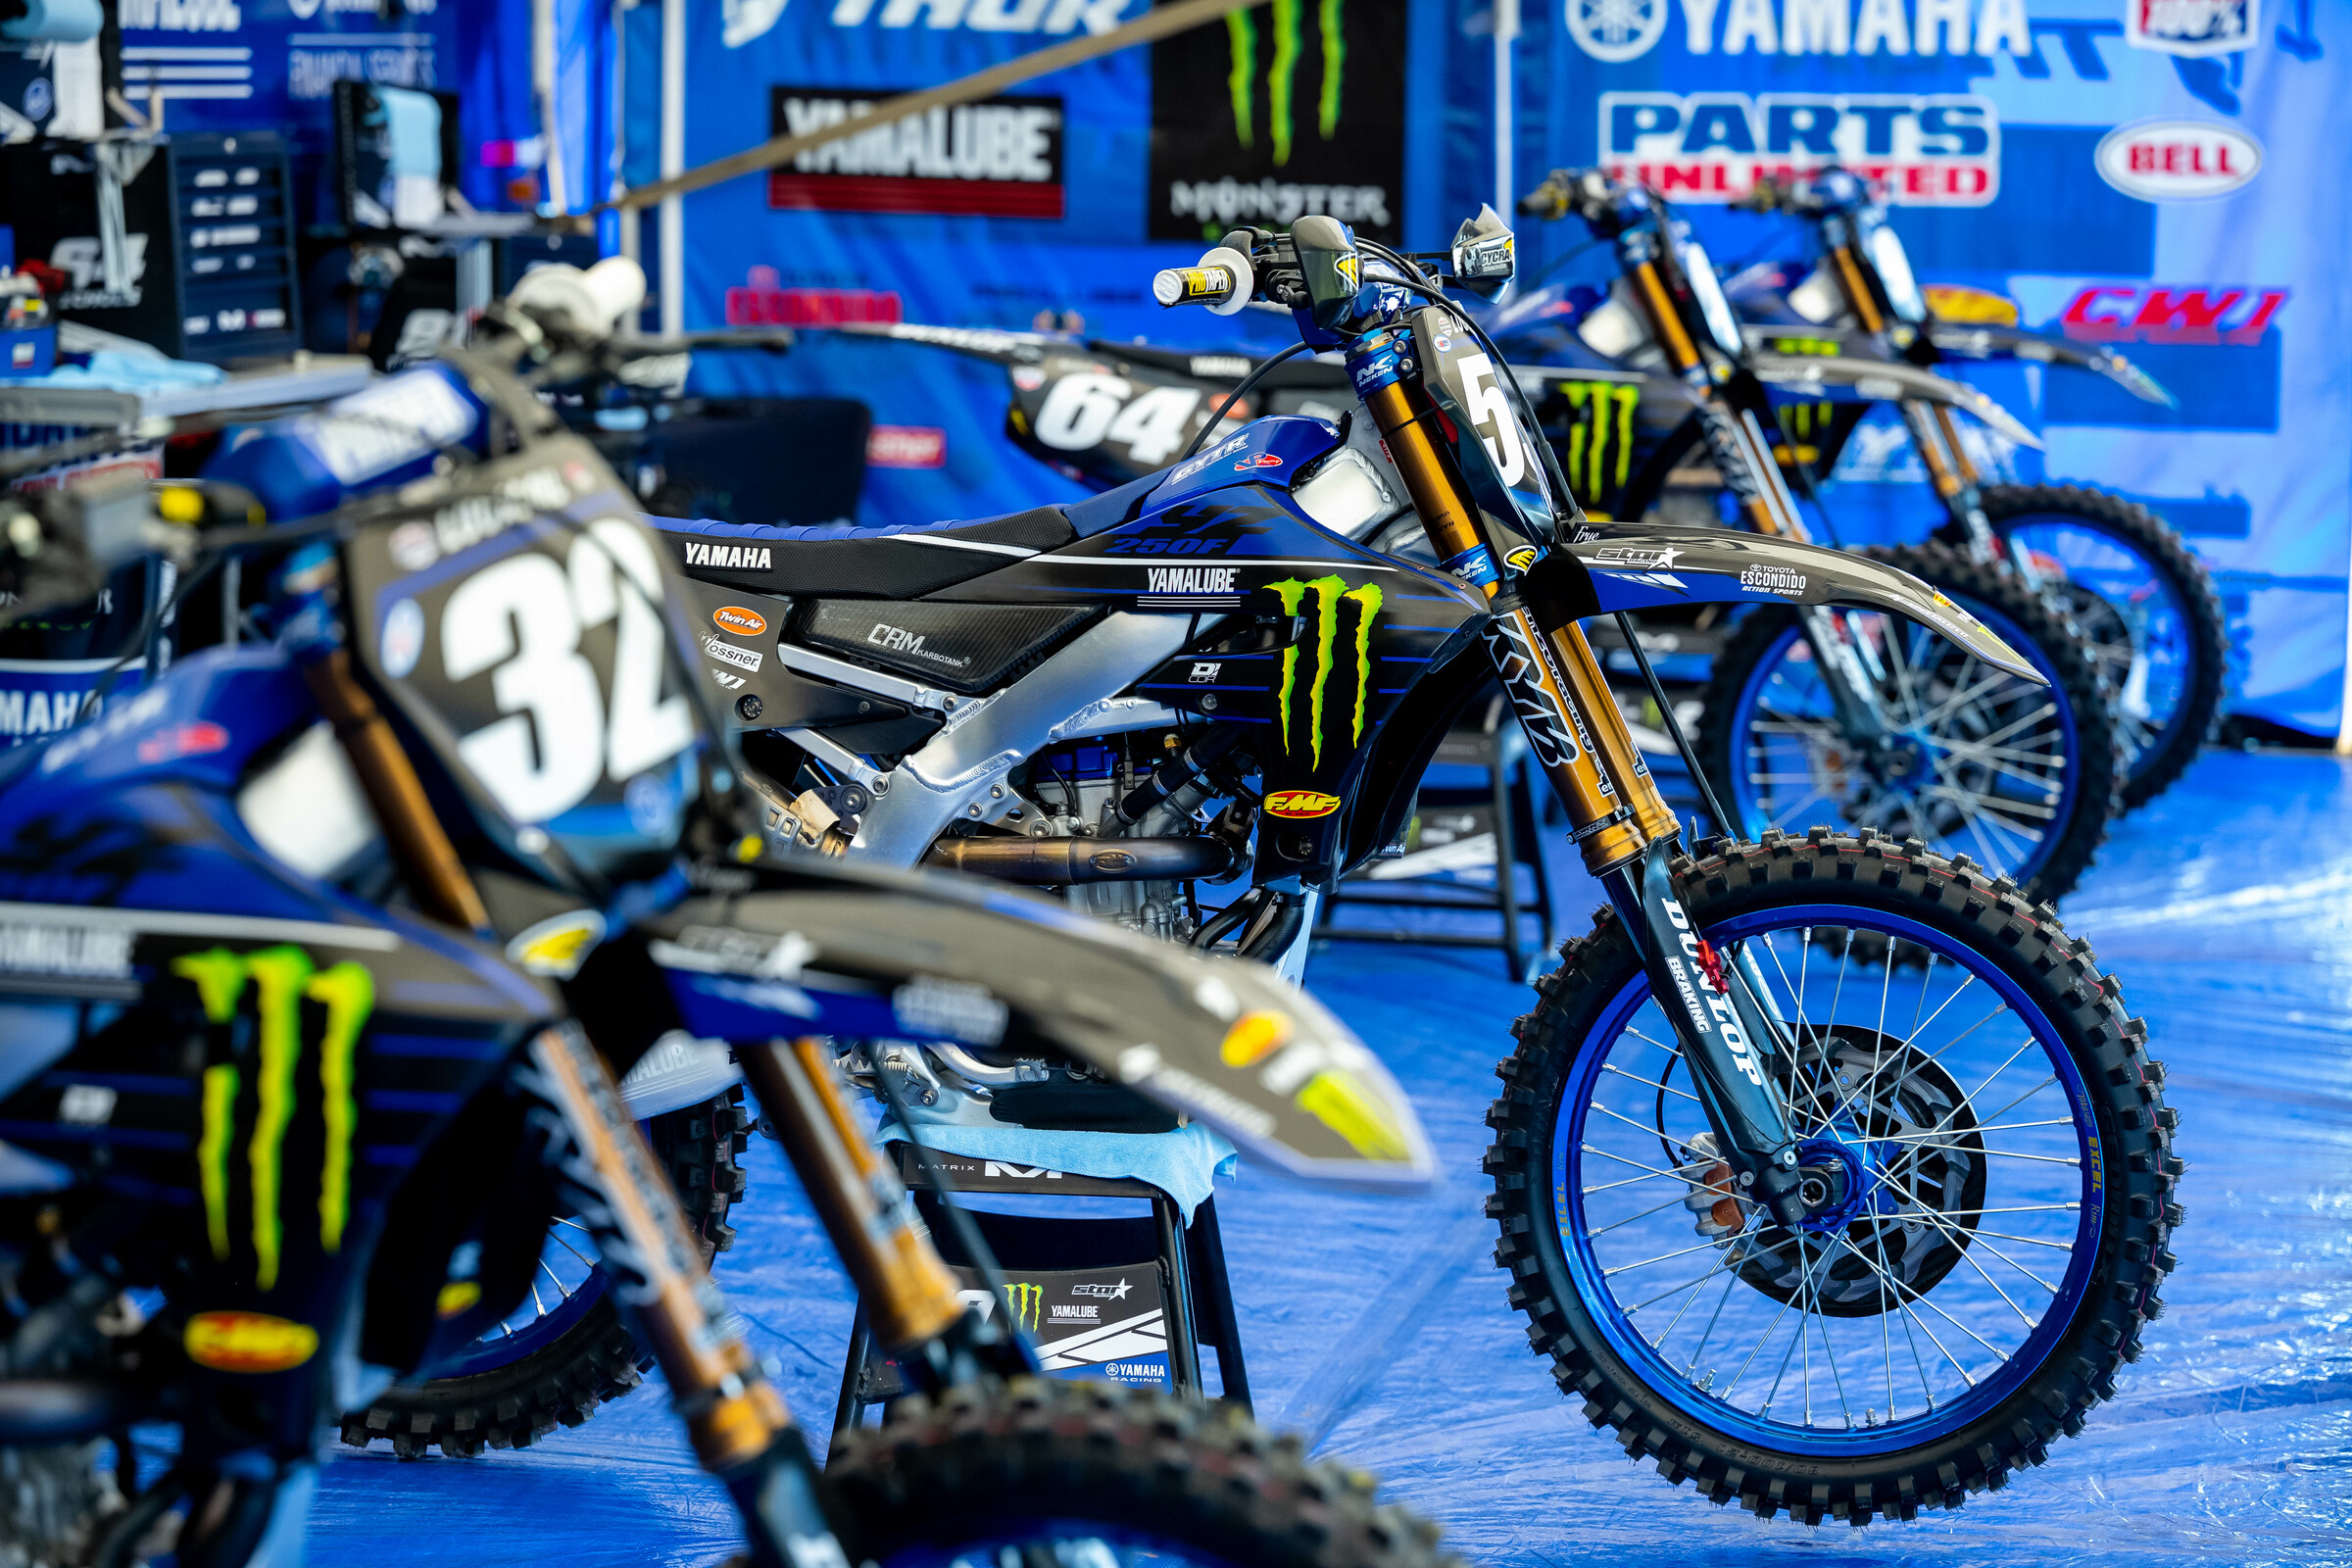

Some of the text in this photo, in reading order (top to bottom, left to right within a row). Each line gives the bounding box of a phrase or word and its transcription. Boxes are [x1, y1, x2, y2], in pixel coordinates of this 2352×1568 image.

[1680, 0, 2032, 57] YAMAHA
[784, 100, 1053, 182] YAMALUBE
[1610, 104, 1989, 154] PARTS
[2128, 143, 2238, 177] BELL
[1034, 371, 1201, 466] 64
[685, 542, 772, 569] YAMAHA
[1103, 538, 1229, 555] 250F
[1148, 567, 1235, 594] YAMALUBE
[1740, 570, 1807, 590] ESCONDIDO
[1762, 565, 1796, 575] TOYOTA
[1741, 585, 1772, 594] ACTION
[717, 611, 746, 625] Twin
[745, 617, 763, 630] Air
[867, 623, 926, 655] CRM
[440, 517, 694, 822] 32
[918, 648, 964, 667] KARBOTANK
[1263, 794, 1341, 811] FMF
[1666, 956, 1712, 1033] BRAKING
[2087, 1136, 2102, 1194] EXCEL
[1051, 1304, 1099, 1318] YAMALUBE
[1119, 1363, 1165, 1377] YAMAHA
